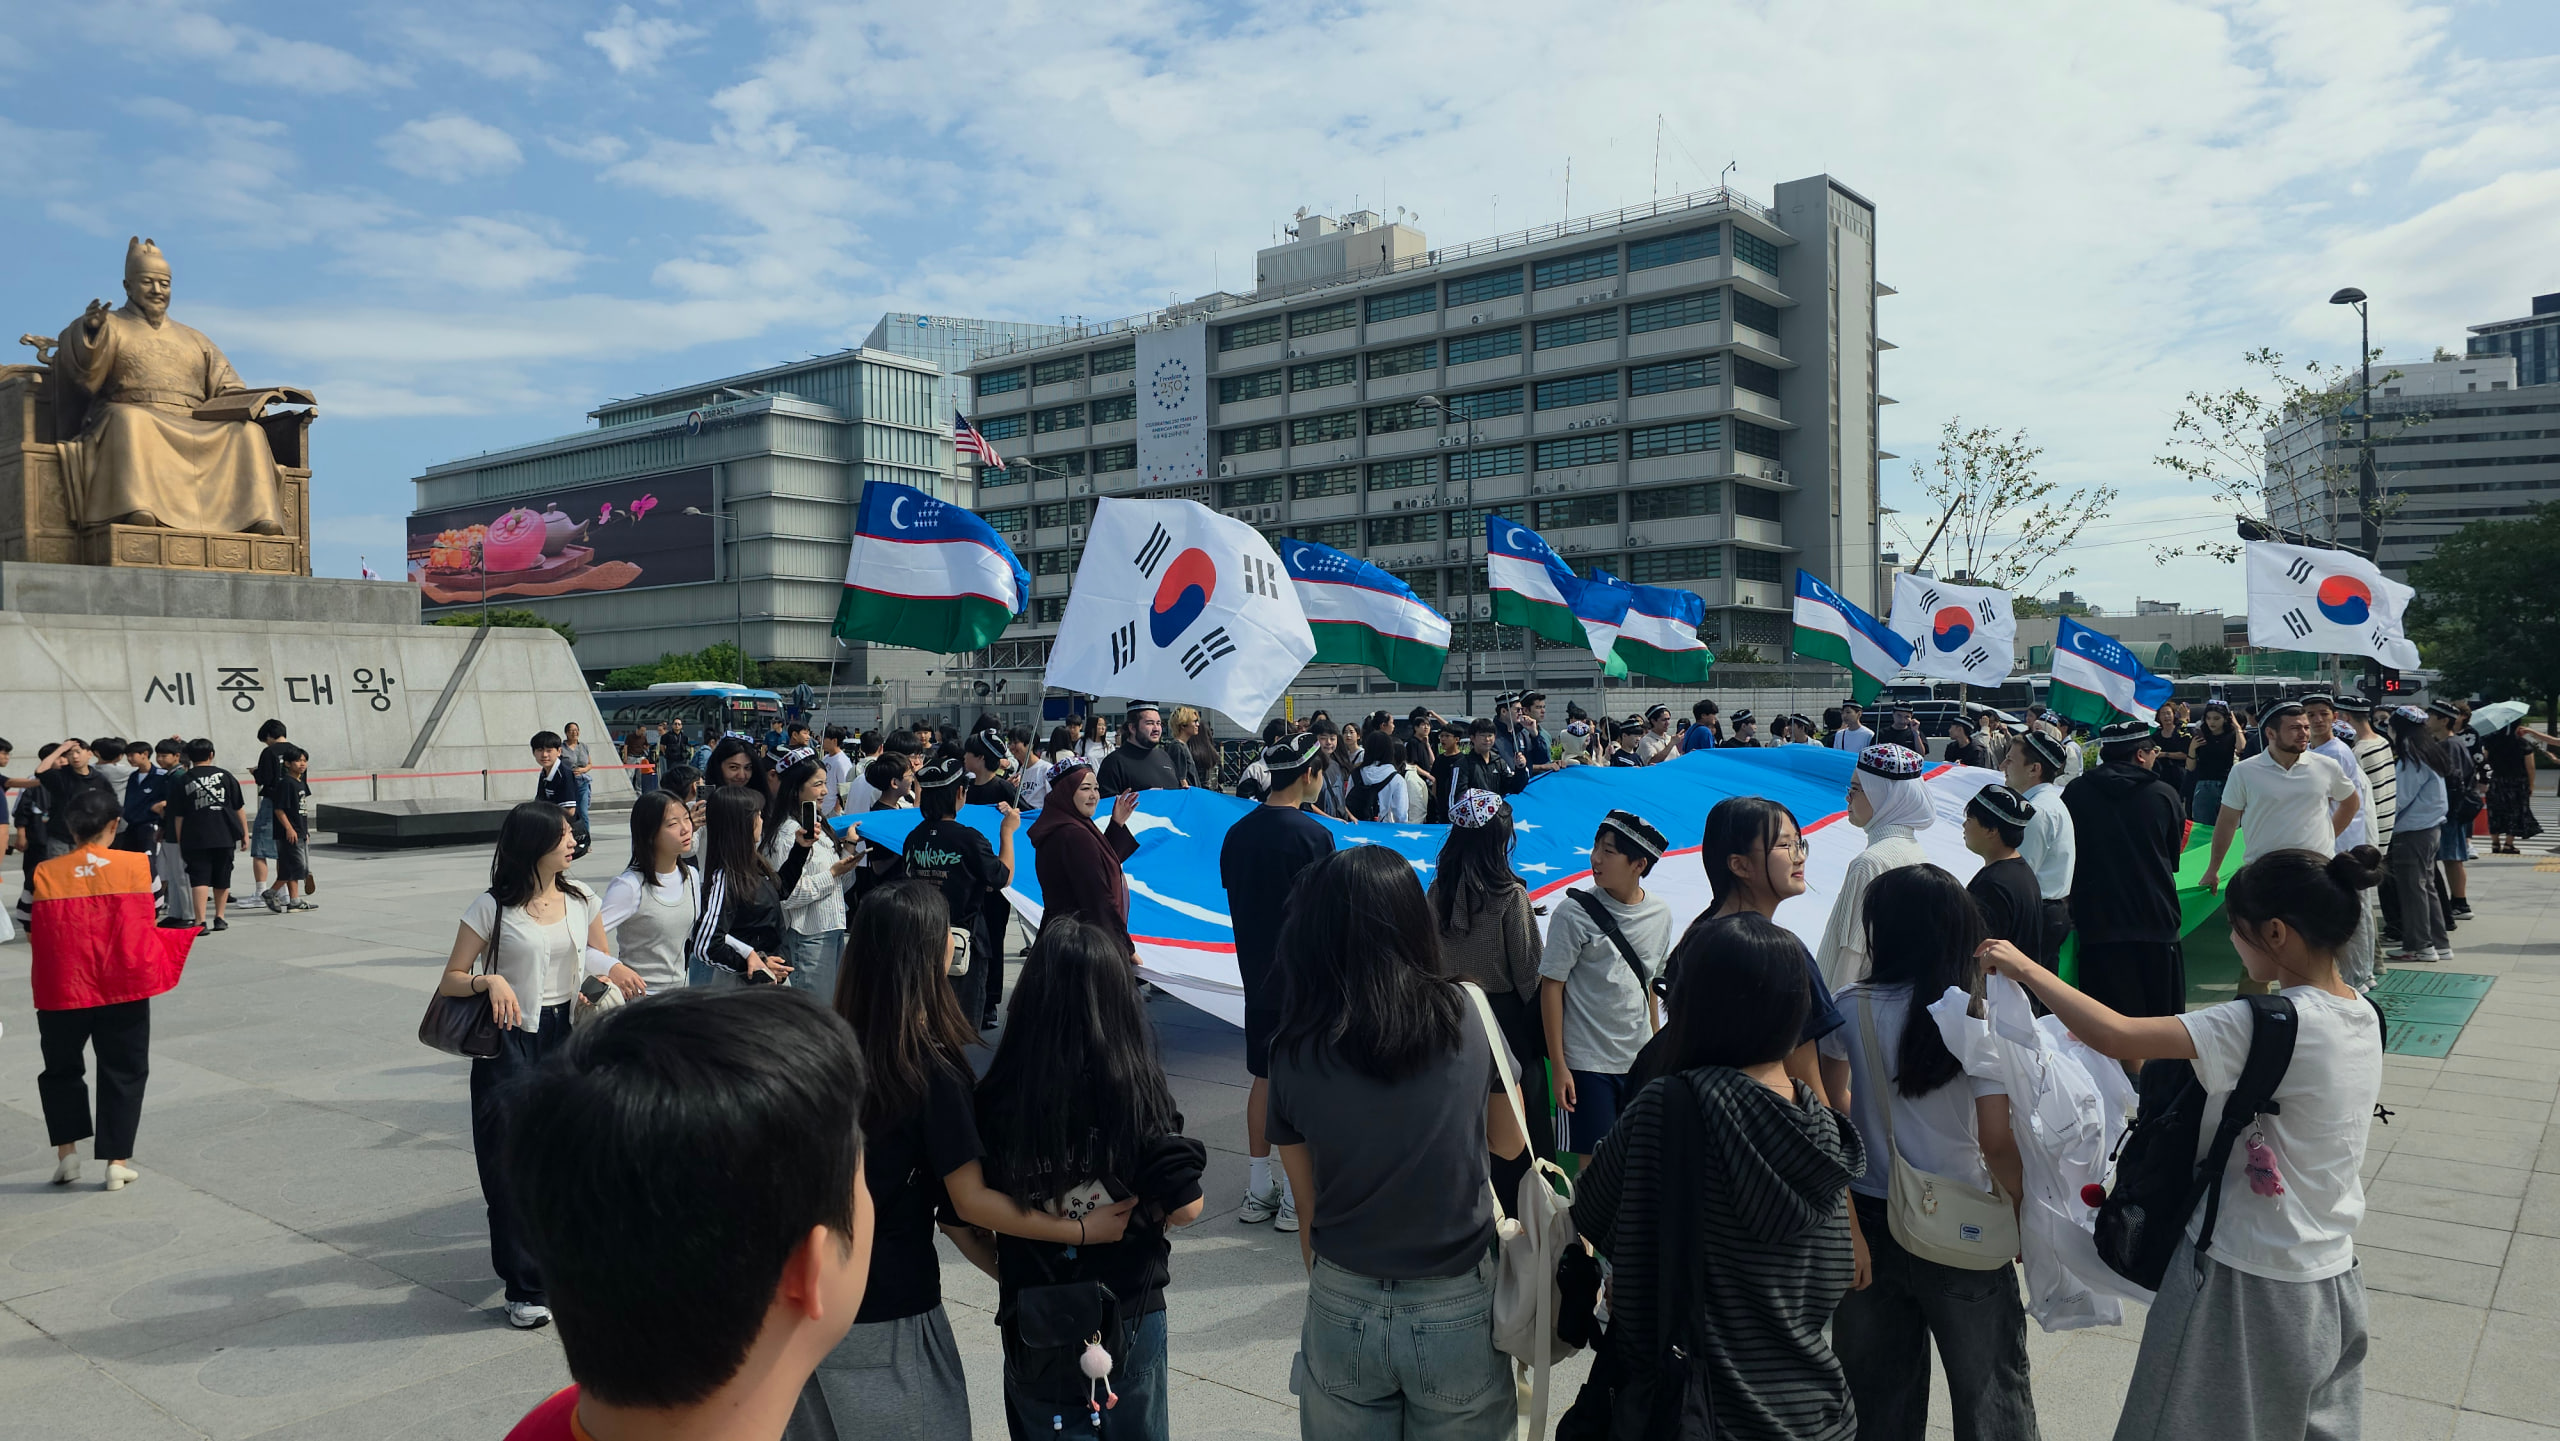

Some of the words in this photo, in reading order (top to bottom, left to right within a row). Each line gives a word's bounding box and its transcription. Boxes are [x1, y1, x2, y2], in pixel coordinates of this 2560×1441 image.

[928, 317, 965, 329] 우리카드
[1161, 380, 1182, 397] 250
[144, 667, 396, 712] 세종대왕
[2386, 680, 2400, 691] 51
[74, 865, 96, 878] SK
